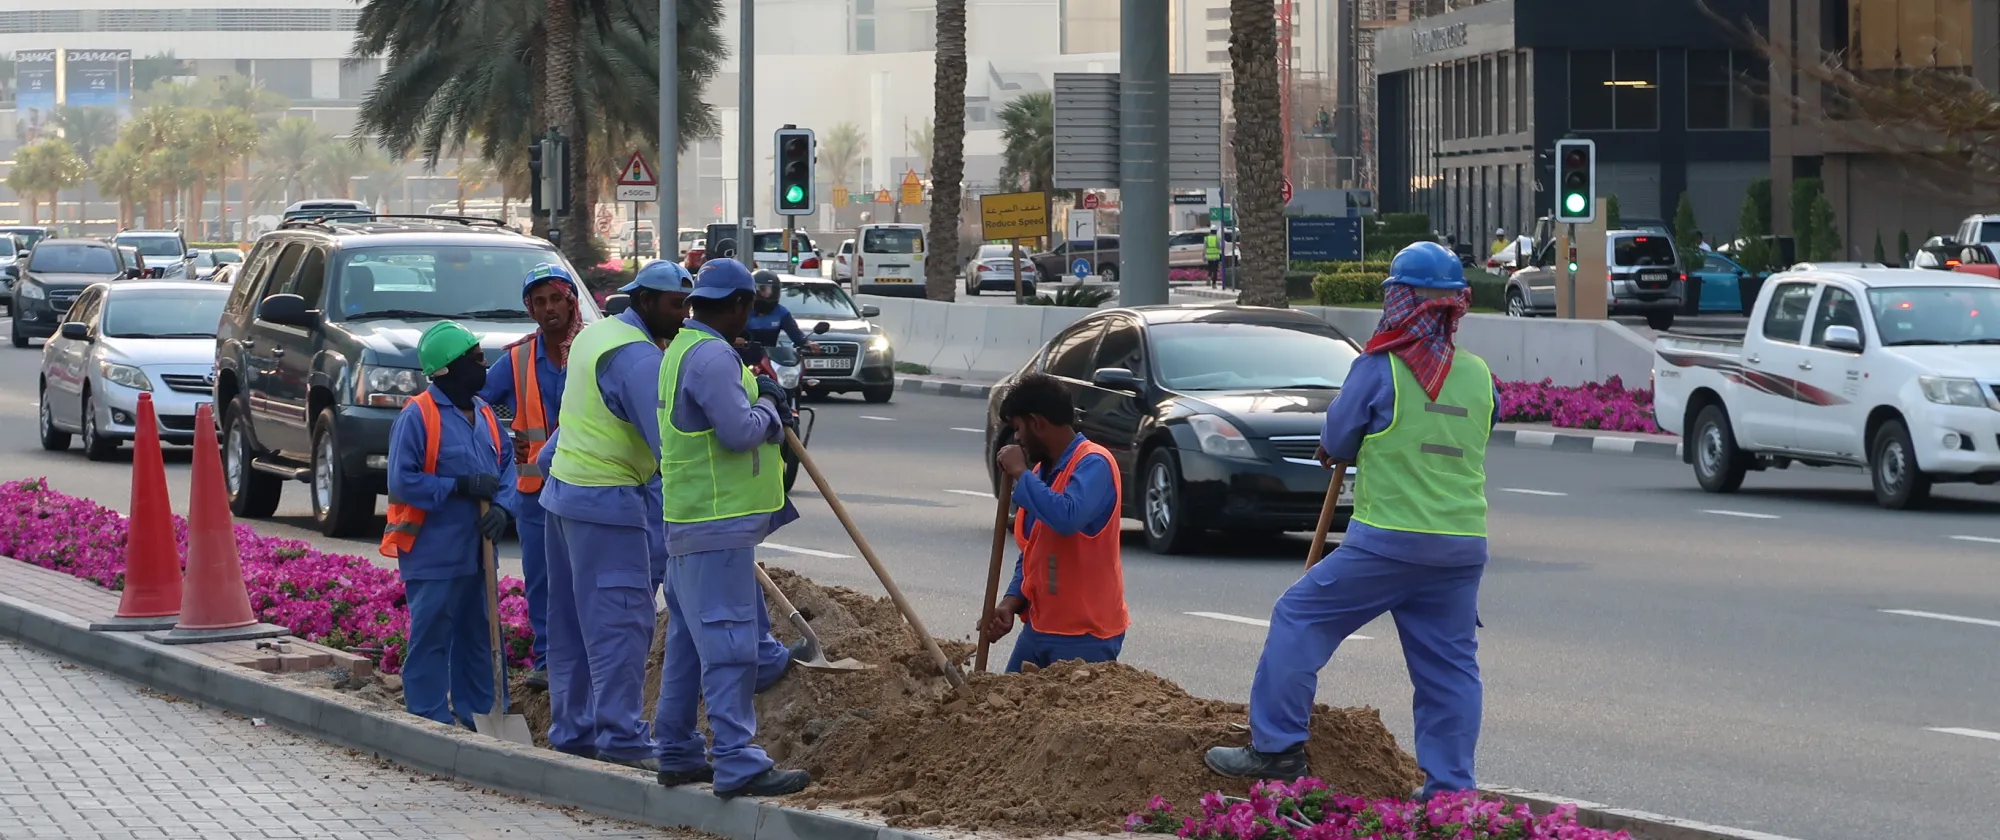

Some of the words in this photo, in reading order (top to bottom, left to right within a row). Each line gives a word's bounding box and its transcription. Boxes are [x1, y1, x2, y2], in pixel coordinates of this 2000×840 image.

[67, 51, 129, 61] DAMAC
[985, 220, 1017, 228] Reduce
[1018, 217, 1044, 226] Speed
